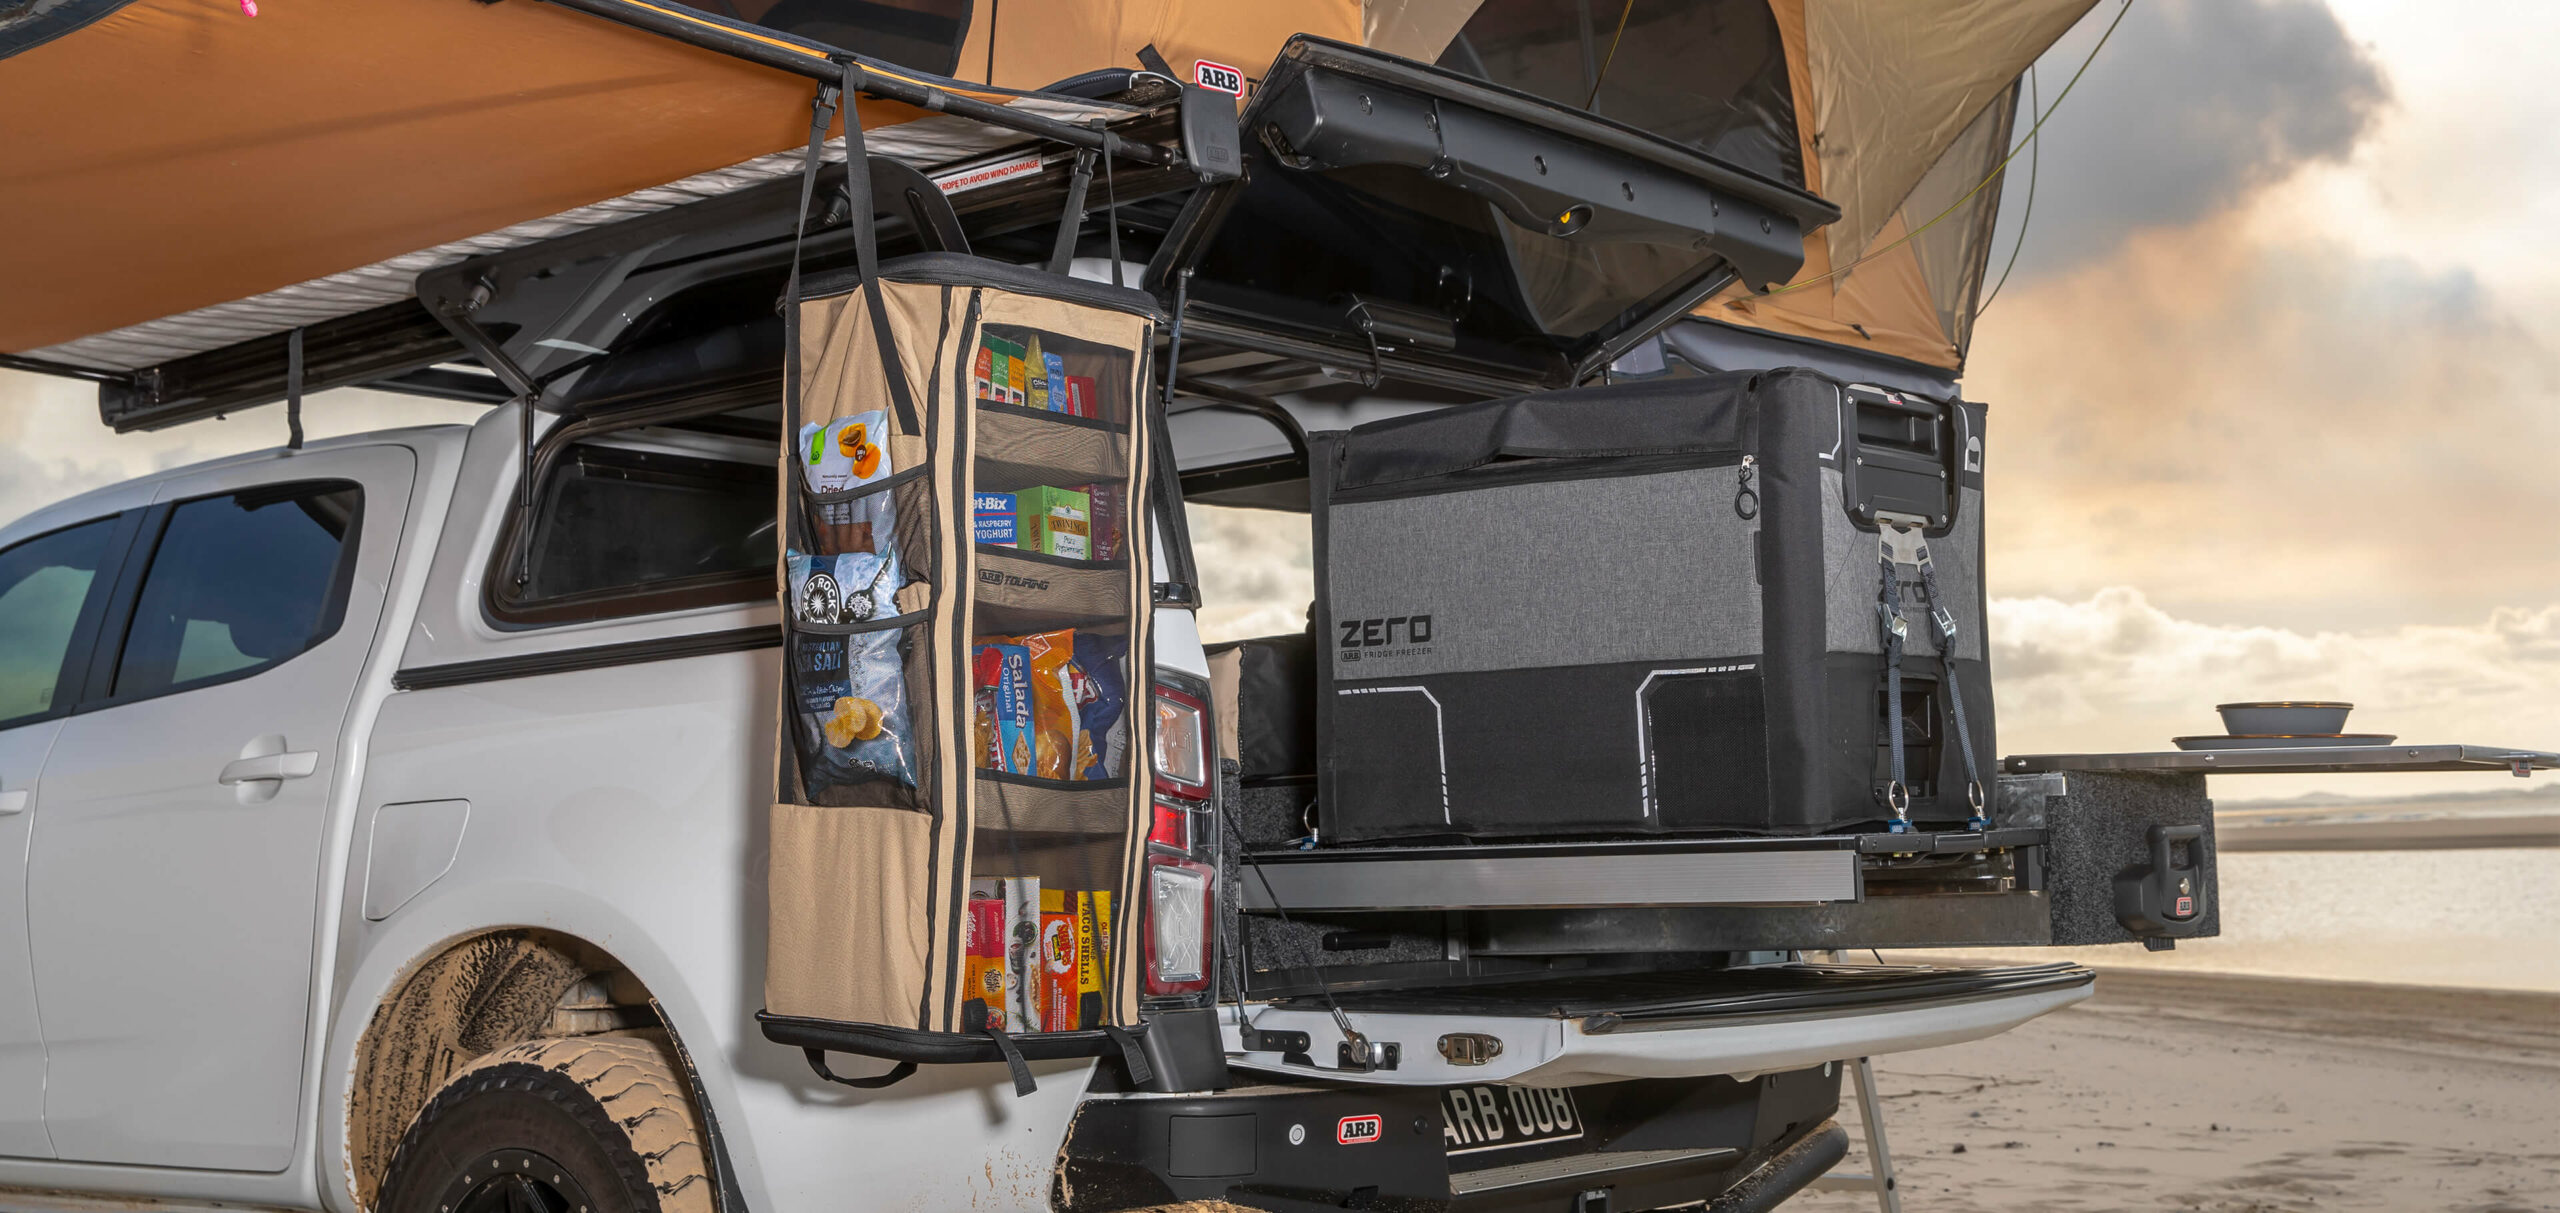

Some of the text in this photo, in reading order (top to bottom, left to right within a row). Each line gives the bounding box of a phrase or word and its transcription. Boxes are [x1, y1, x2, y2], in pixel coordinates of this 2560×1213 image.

[1202, 67, 1239, 92] ARB
[942, 179, 960, 191] ROPE
[960, 177, 969, 186] TO
[969, 173, 990, 184] AVOID
[990, 167, 1009, 179] WIND
[1009, 159, 1039, 176] DAMAGE
[975, 528, 1013, 540] YOGHURT
[978, 519, 1012, 528] RASPBERRY
[981, 571, 1050, 590] ARB TOURING
[817, 577, 836, 609] ROCK
[814, 651, 843, 672] SALT
[1364, 651, 1393, 659] FRIDGE
[1396, 647, 1432, 656] FREEZER
[1002, 667, 1013, 713] Original
[1008, 654, 1029, 729] Salada
[1080, 901, 1091, 985] TACO SHELLS
[1343, 1121, 1376, 1138] ARB
